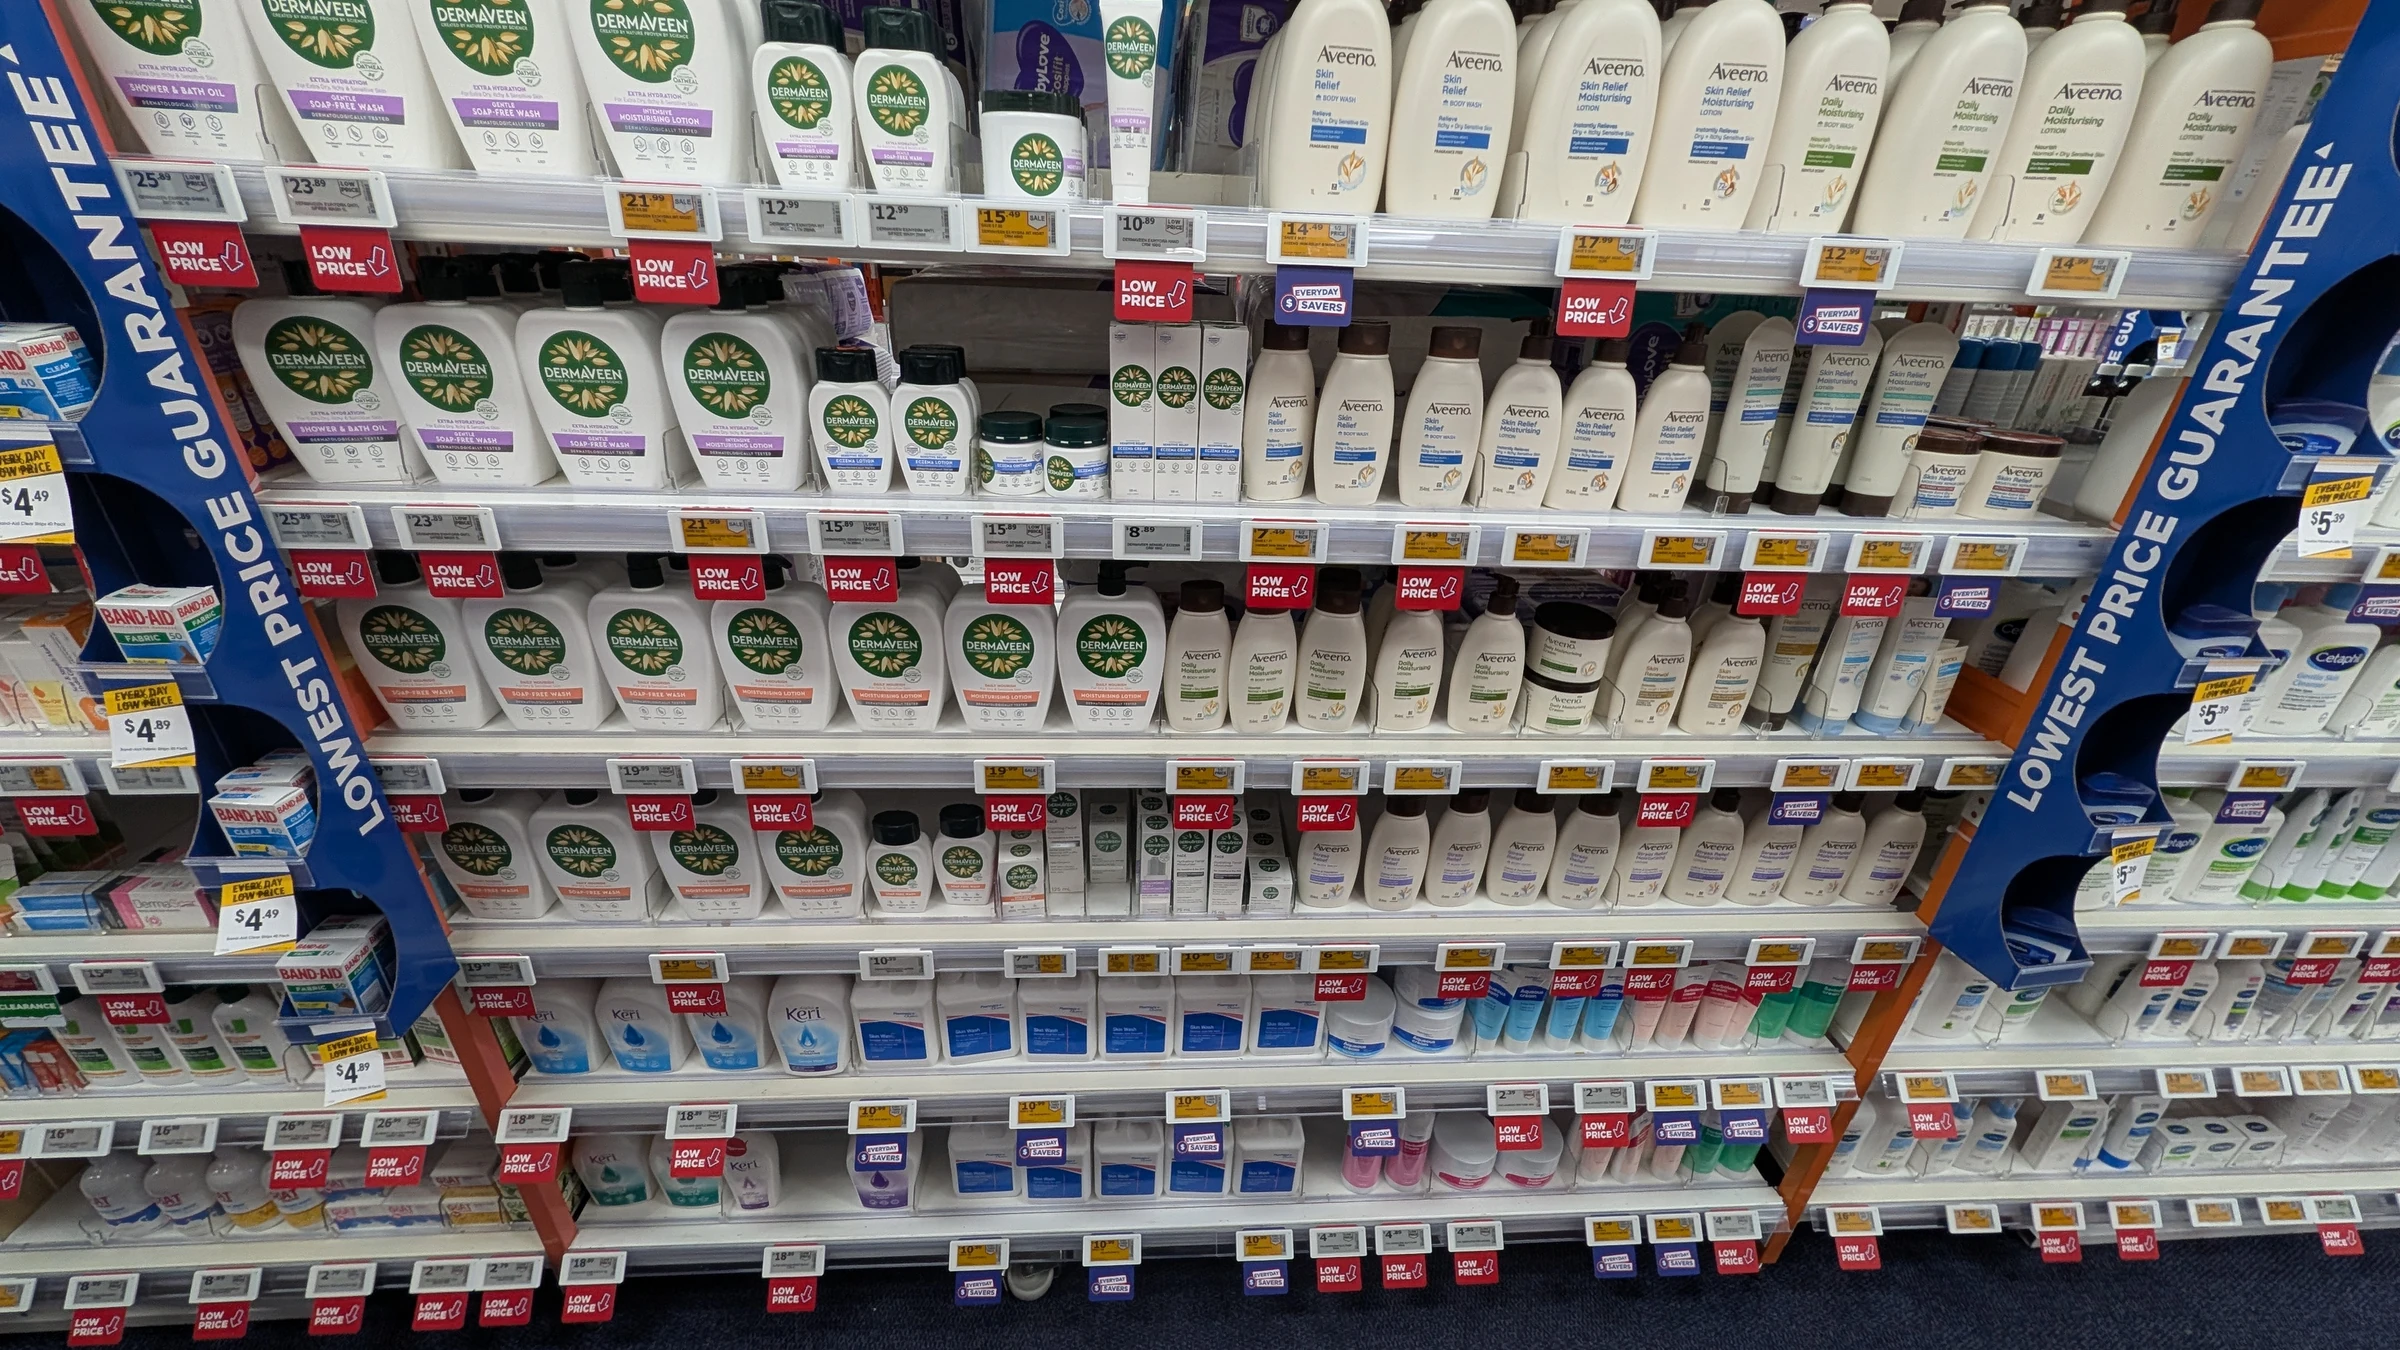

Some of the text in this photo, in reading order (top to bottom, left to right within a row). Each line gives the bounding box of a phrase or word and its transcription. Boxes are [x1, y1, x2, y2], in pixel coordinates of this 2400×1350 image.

[437, 6, 526, 26] DERMAVEEN
[597, 12, 688, 34] DERMAVEEN
[1107, 41, 1155, 53] DERMAVEEN
[1316, 69, 1333, 78] Skin
[130, 84, 225, 97] SHOWER & BATH OIL
[1315, 81, 1340, 90] Relief
[1580, 82, 1628, 92] Skin Relief
[870, 94, 926, 107] DERMAVEEN
[1578, 93, 1632, 105] Moisturising
[309, 101, 384, 111] SOAP-FREE WASH
[2048, 105, 2075, 116] Daily
[620, 114, 670, 124] MOISTURISING
[2044, 116, 2104, 127] Moisturising
[1014, 159, 1062, 170] DERMAVEEN
[127, 171, 171, 188] $25.89
[284, 177, 326, 194] $23.89
[870, 205, 908, 220] $12.99
[1118, 216, 1155, 231] $10.89
[312, 246, 352, 260] LOW
[7, 71, 226, 479] GUARANTEE
[317, 262, 366, 276] PRICE
[1121, 281, 1156, 293] LOW
[1295, 287, 1339, 297] EVERYDAY
[1121, 295, 1165, 308] PRICE
[1301, 301, 1343, 313] SAVERS
[1567, 298, 1600, 309] LOW
[1565, 312, 1606, 324] PRICE
[1818, 308, 1858, 318] EVERYDAY
[1821, 322, 1859, 333] SAVERS
[22, 340, 66, 356] BAND-AID
[272, 353, 366, 366] DERMAVEEN
[45, 362, 70, 374] CLEAR
[406, 360, 487, 375] DERMAVEEN
[689, 368, 765, 382] DERMAVEEN
[21, 378, 35, 388] 40
[1114, 381, 1151, 391] DERMAVEEN
[825, 417, 876, 427] DERMAVEEN
[2007, 646, 2106, 812] LOWEST
[2087, 509, 2177, 644] PRICE
[2157, 163, 2353, 500] GUARANTEE
[2, 487, 49, 516] $4.49
[821, 520, 853, 533] $15.89
[2311, 511, 2345, 535] $5.39
[1125, 525, 1155, 538] $8.89
[205, 491, 302, 646] PRICE
[297, 562, 332, 573] LOW
[302, 575, 345, 585] PRICE
[1252, 576, 1282, 586] LOW
[1252, 587, 1289, 597] PRICE
[1953, 589, 1987, 598] EVERYDAY
[1956, 600, 1988, 609] SAVERS
[101, 608, 175, 625] BAND-AID
[124, 632, 183, 643] FABRIC 50
[366, 632, 440, 646] DERMAVEEN
[852, 639, 918, 650] DERMAVEEN
[2199, 705, 2229, 725] $5.39
[124, 719, 171, 742] $4.89
[281, 656, 385, 836] LOWEST
[216, 808, 277, 824] BAND-AID
[674, 844, 734, 854] DERMAVEEN
[235, 908, 279, 931] $4.49
[280, 969, 342, 980] BAND-AID
[612, 1009, 638, 1021] Keri
[786, 1007, 821, 1023] Keri
[336, 1062, 370, 1084] $4.89
[1788, 1117, 1808, 1125] LOW
[1789, 1126, 1816, 1134] PRICE
[1031, 1148, 1061, 1157] SAVERS
[276, 1161, 302, 1170] LOW
[506, 1155, 531, 1164] LOW
[504, 1163, 536, 1172] PRICE
[730, 1161, 759, 1172] Keri
[274, 1169, 307, 1179] PRICE
[2121, 1237, 2138, 1245] LOW
[2122, 1244, 2144, 1252] PRICE
